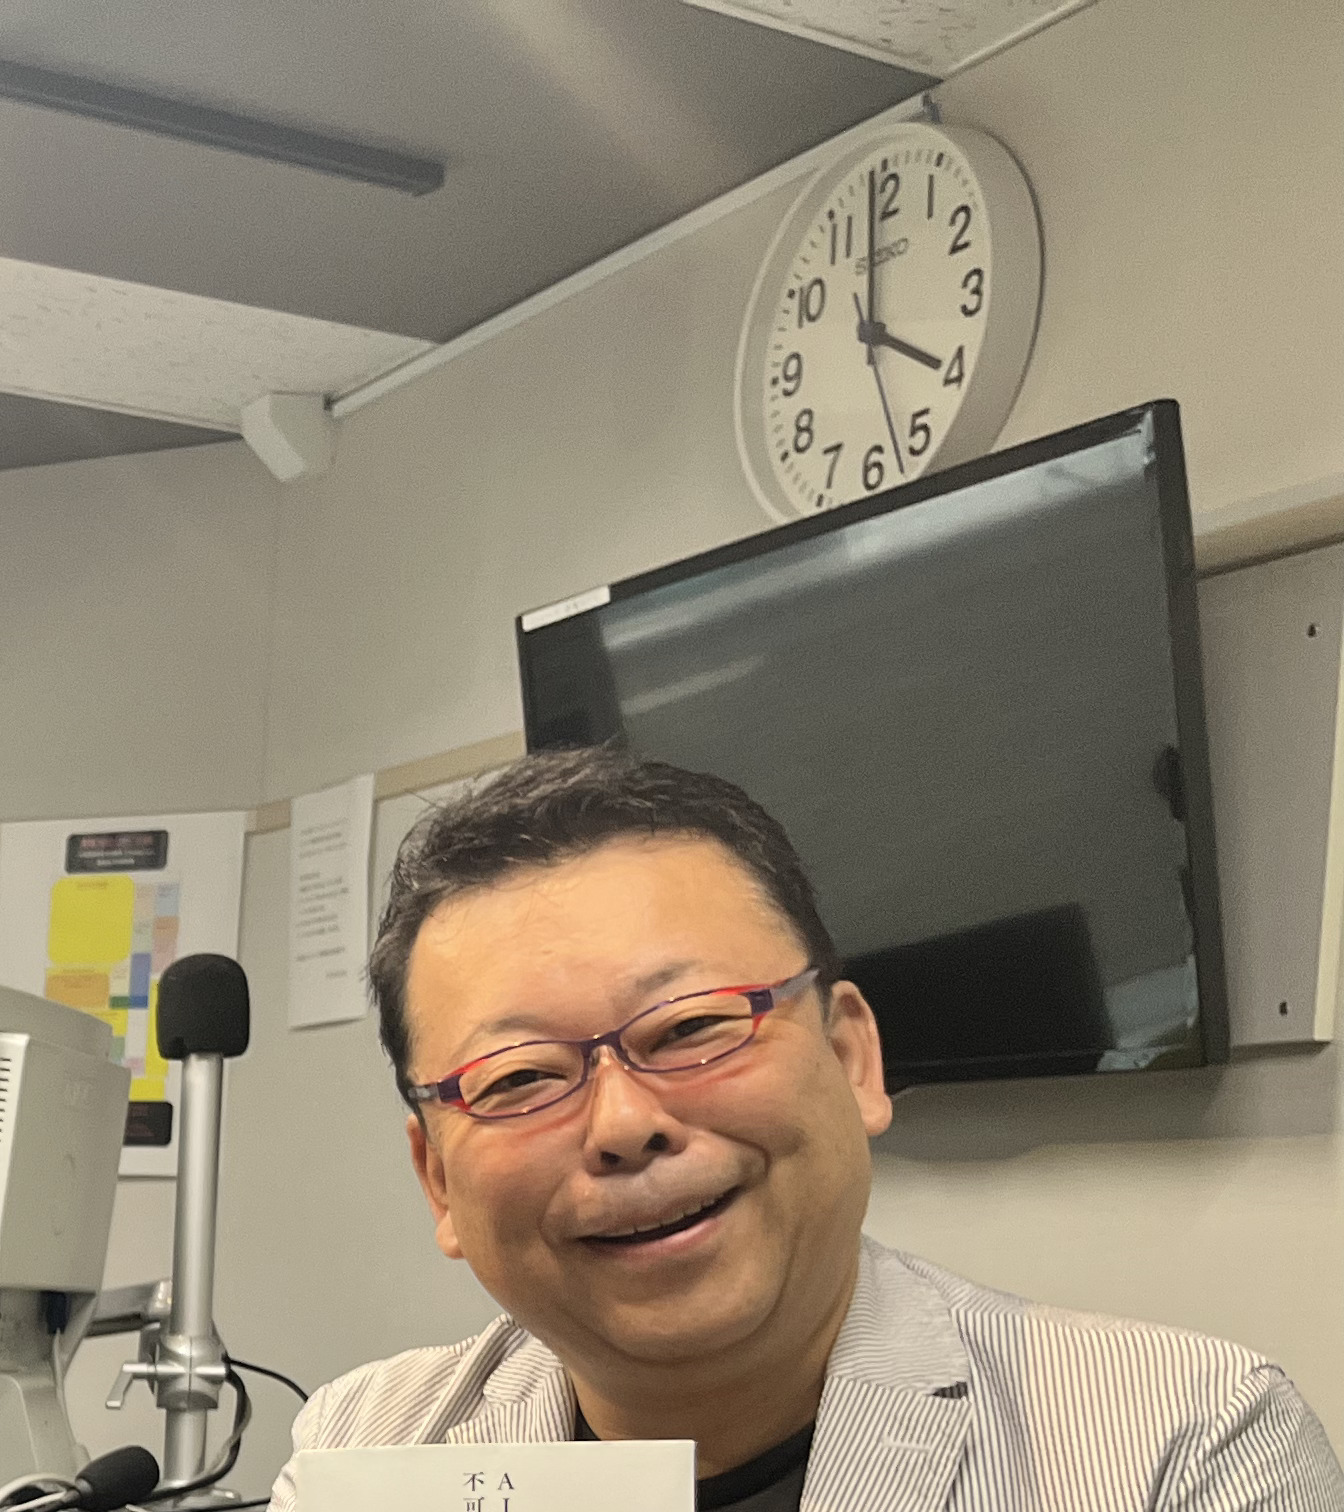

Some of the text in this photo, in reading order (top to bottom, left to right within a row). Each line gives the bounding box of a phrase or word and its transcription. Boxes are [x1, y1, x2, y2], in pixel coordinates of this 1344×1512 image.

[926, 172, 935, 221] 1
[829, 214, 854, 266] 11
[947, 203, 973, 257] 2
[797, 277, 827, 329] 10
[960, 267, 985, 318] 3
[781, 352, 804, 398] 9
[941, 344, 966, 388] 4
[792, 407, 815, 454] 8
[908, 407, 932, 457] 5
[821, 442, 845, 490] 7
[861, 444, 886, 491] 6
